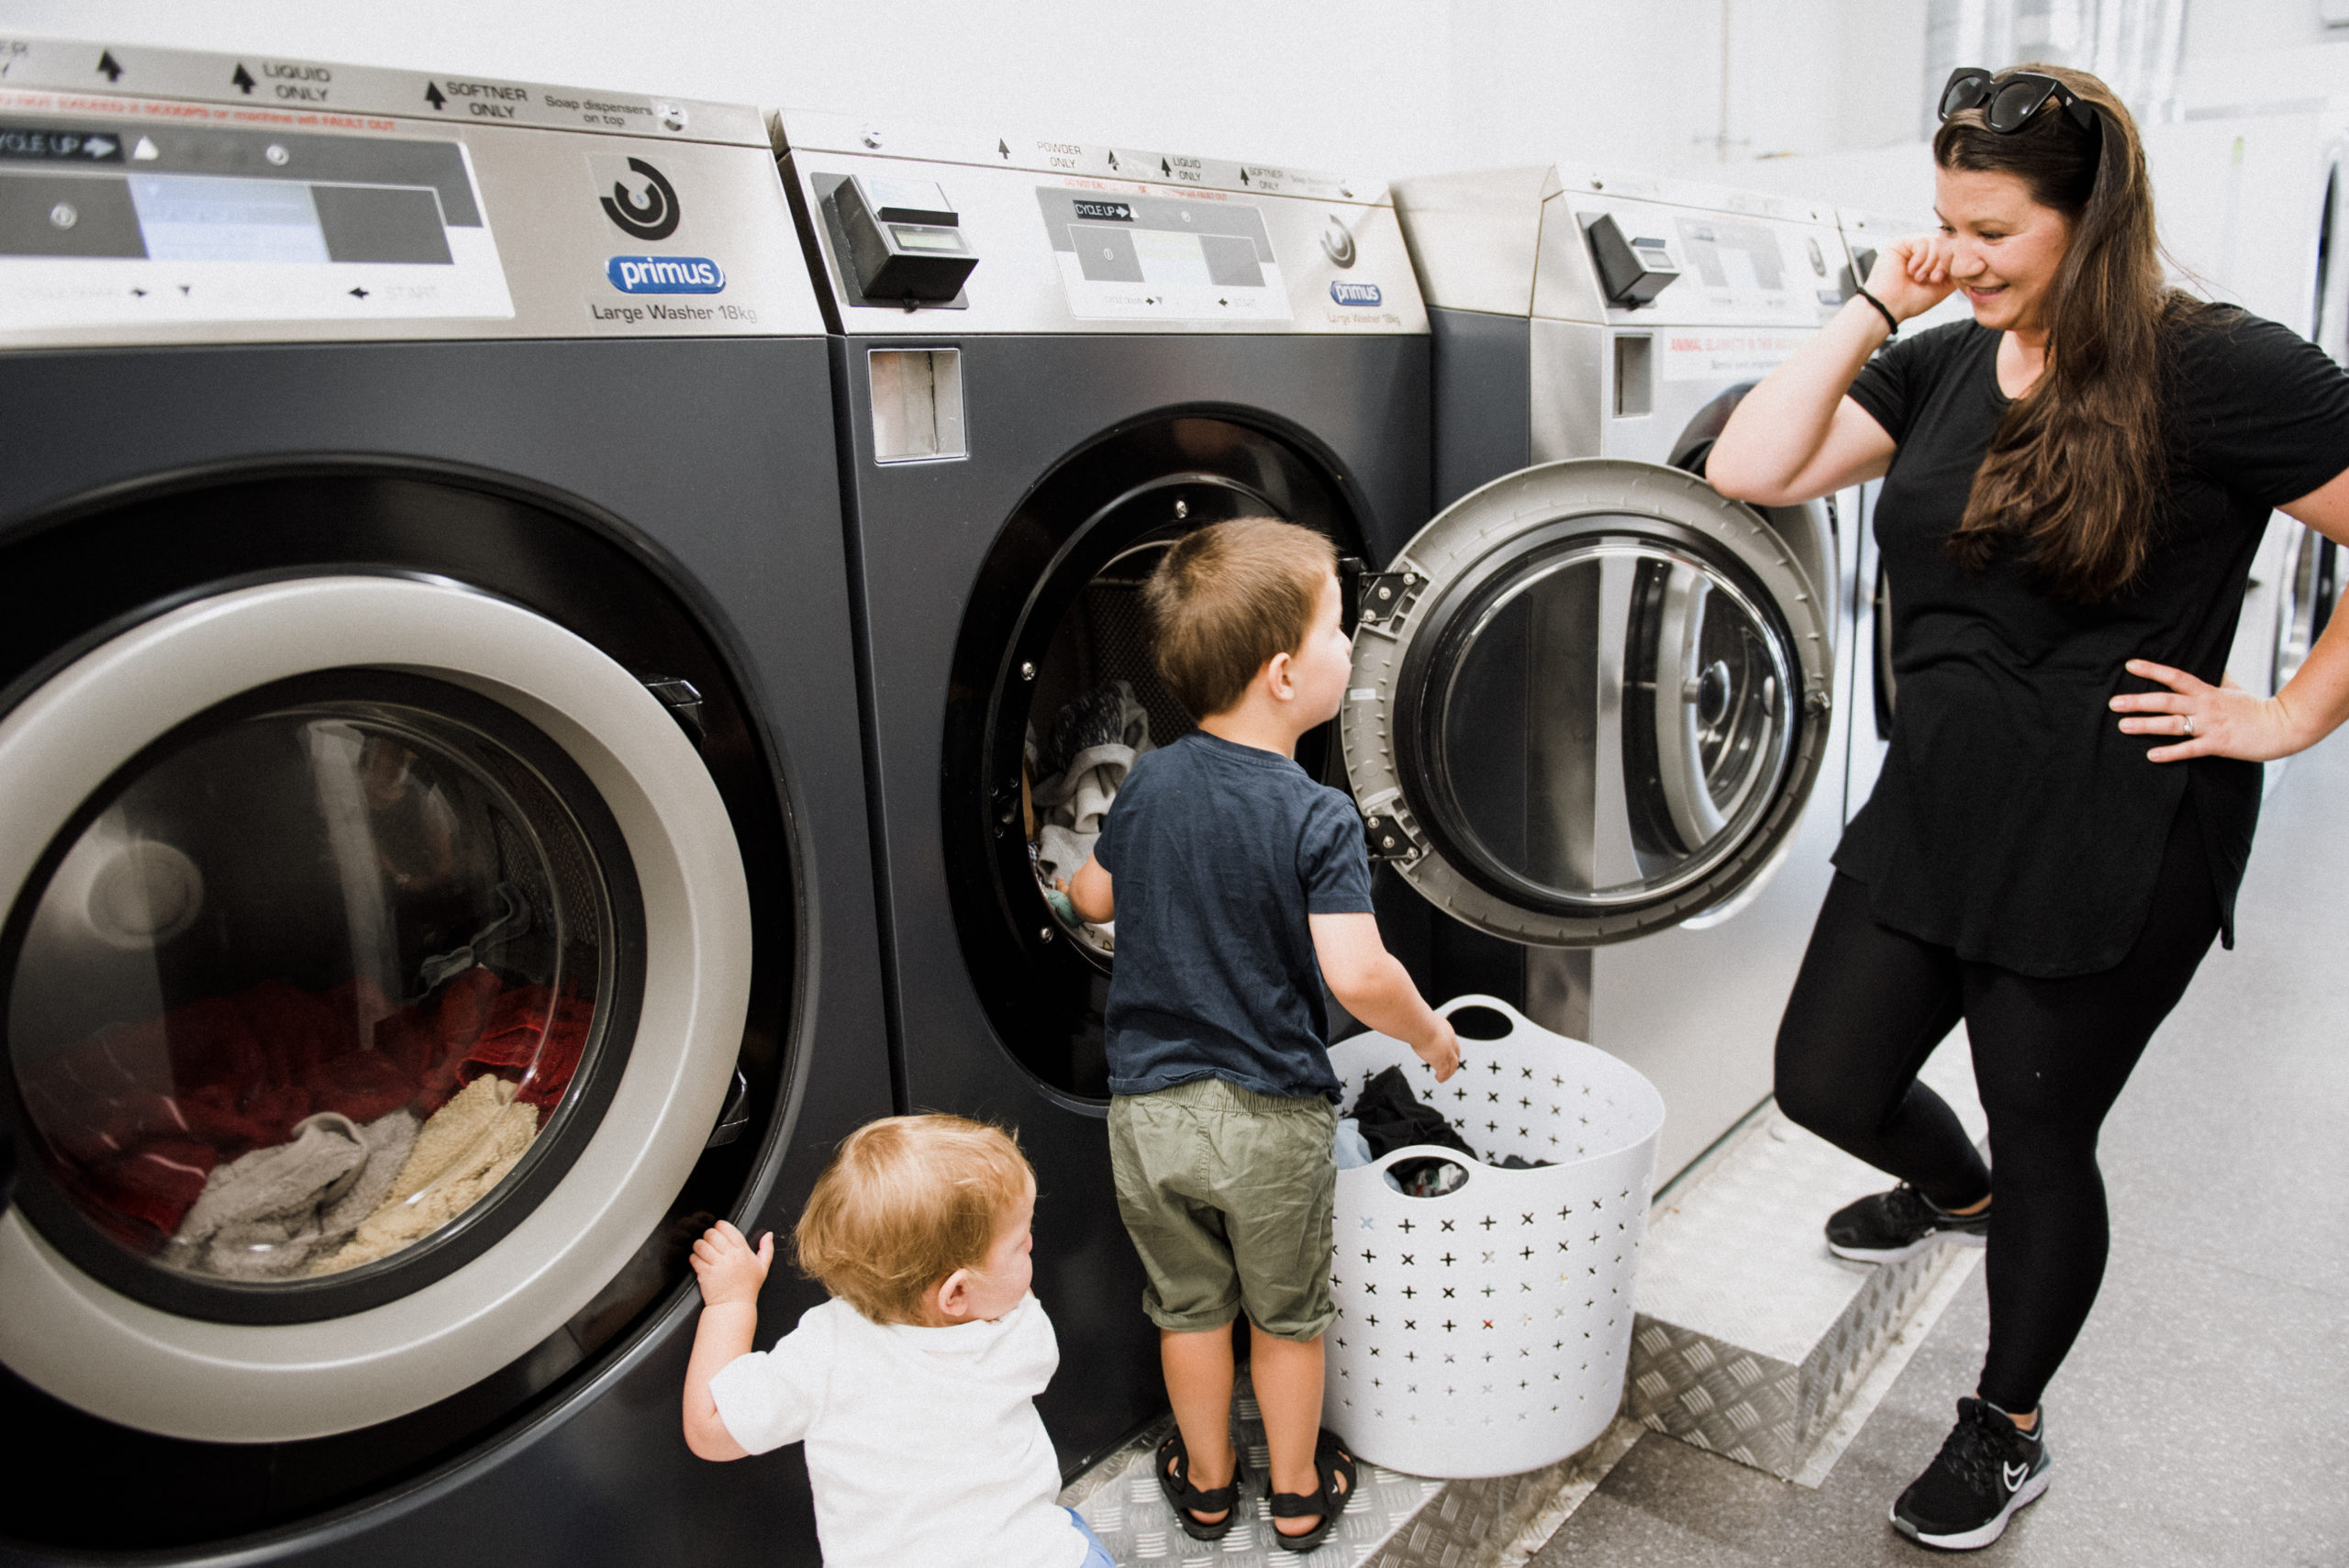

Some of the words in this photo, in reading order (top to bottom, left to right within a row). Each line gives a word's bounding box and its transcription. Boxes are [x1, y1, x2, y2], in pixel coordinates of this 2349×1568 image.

[262, 63, 331, 83] LIQUID
[275, 84, 328, 102] ONLY
[446, 82, 528, 102] SOFTNER
[469, 102, 515, 118] ONLY
[545, 95, 579, 110] Soap
[583, 99, 653, 116] dispensers
[584, 115, 600, 125] on
[603, 114, 625, 127] top
[1036, 141, 1083, 155] POWDER
[1050, 157, 1075, 169] ONLY
[1173, 158, 1201, 169] LIQUID
[1178, 171, 1201, 182] ONLY
[1074, 204, 1104, 216] CYCLE
[1103, 205, 1115, 217] UP
[619, 257, 716, 290] primus
[1335, 284, 1379, 304] primus
[592, 304, 644, 324] Large
[646, 304, 714, 320] Washer
[718, 305, 758, 324] 18kg
